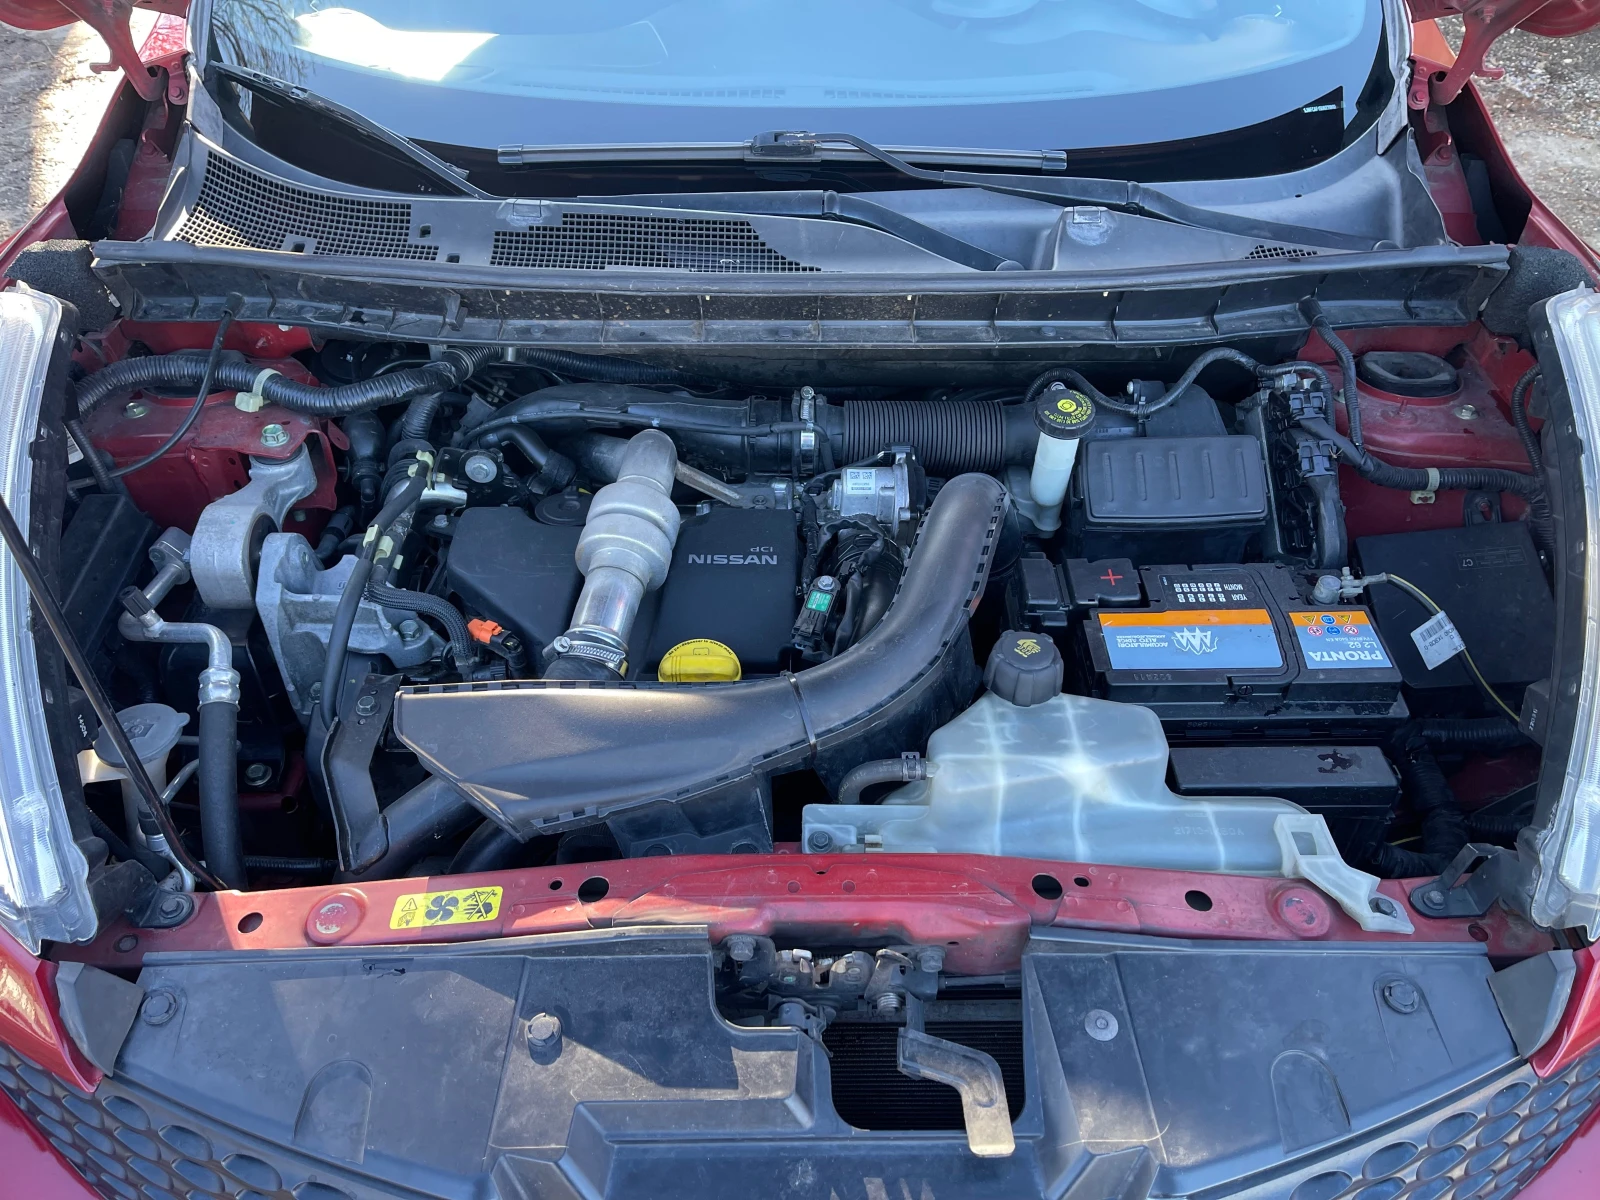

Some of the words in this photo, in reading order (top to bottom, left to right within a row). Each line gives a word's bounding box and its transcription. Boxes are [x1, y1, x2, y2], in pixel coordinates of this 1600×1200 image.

[688, 554, 778, 565] NISSAN
[1223, 583, 1243, 591] MONTH
[1231, 593, 1248, 601] YEAR
[1347, 641, 1361, 649] 62
[1308, 650, 1383, 661] PRONTA
